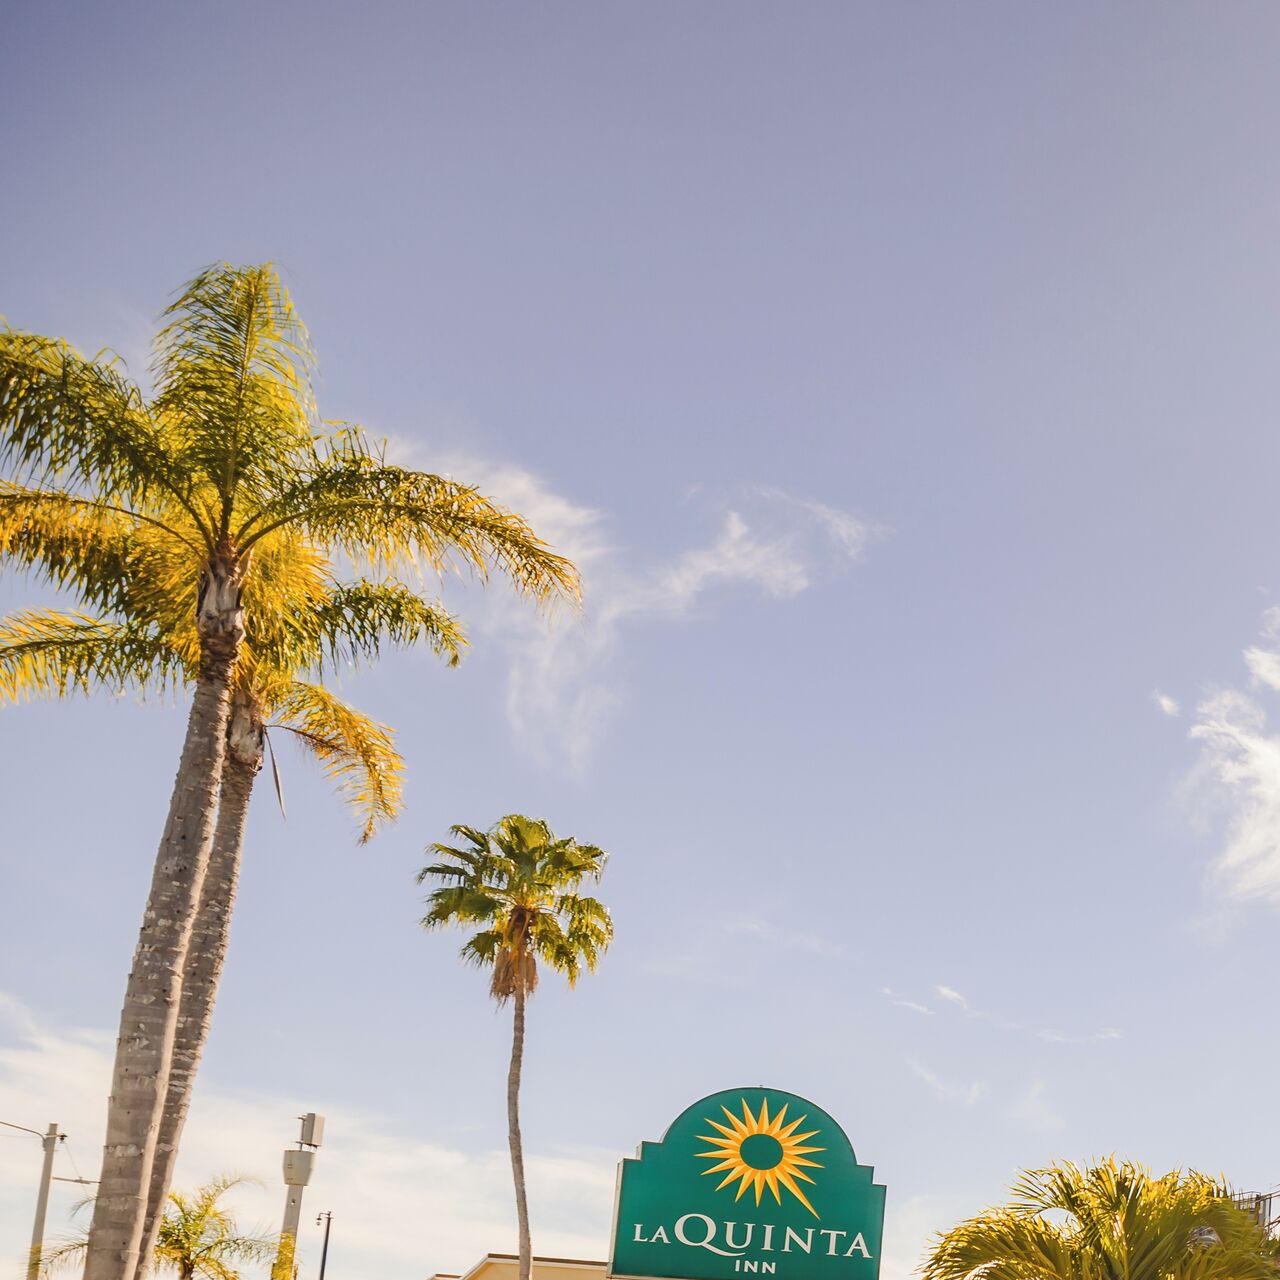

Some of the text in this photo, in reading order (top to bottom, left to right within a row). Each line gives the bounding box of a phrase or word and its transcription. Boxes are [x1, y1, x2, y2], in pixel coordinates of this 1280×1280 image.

[633, 1213, 873, 1259] LA QUINTA
[735, 1260, 776, 1274] INN
